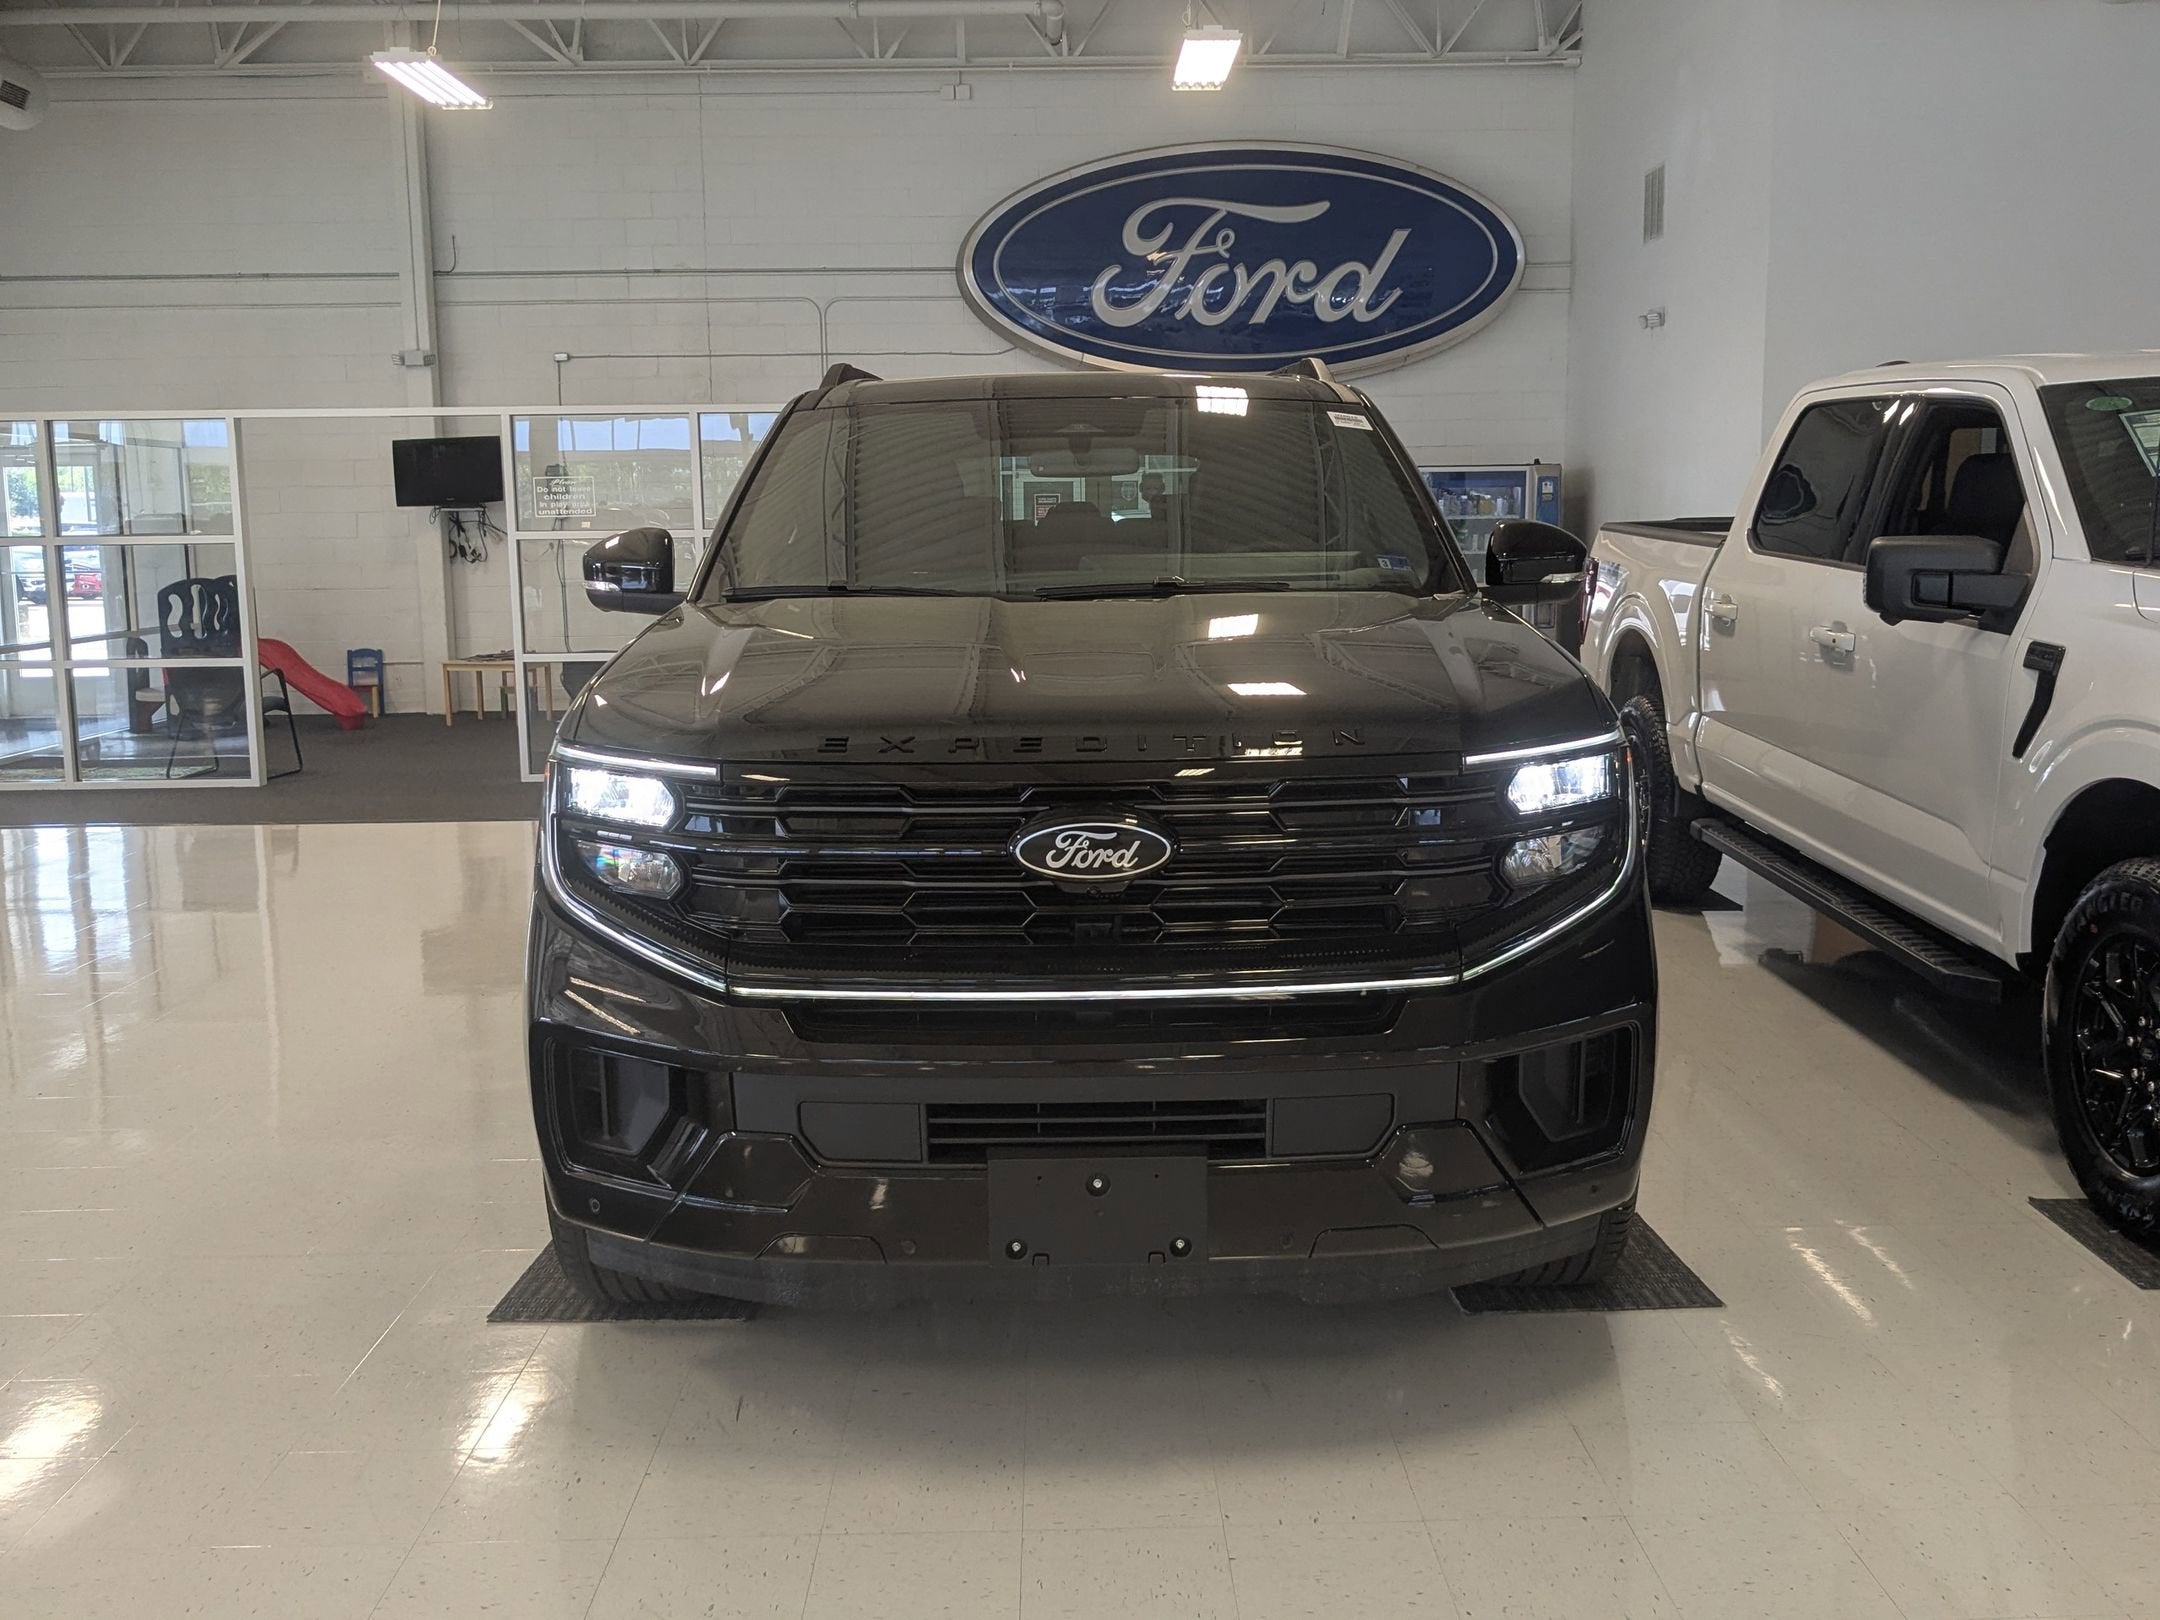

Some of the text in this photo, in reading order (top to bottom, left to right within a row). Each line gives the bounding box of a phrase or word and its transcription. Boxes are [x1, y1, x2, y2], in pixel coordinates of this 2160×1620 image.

[1091, 198, 1412, 328] Ford
[538, 507, 593, 515] unattended
[550, 501, 568, 509] play
[817, 727, 1366, 754] EXPEDITION
[1045, 831, 1142, 869] Ford
